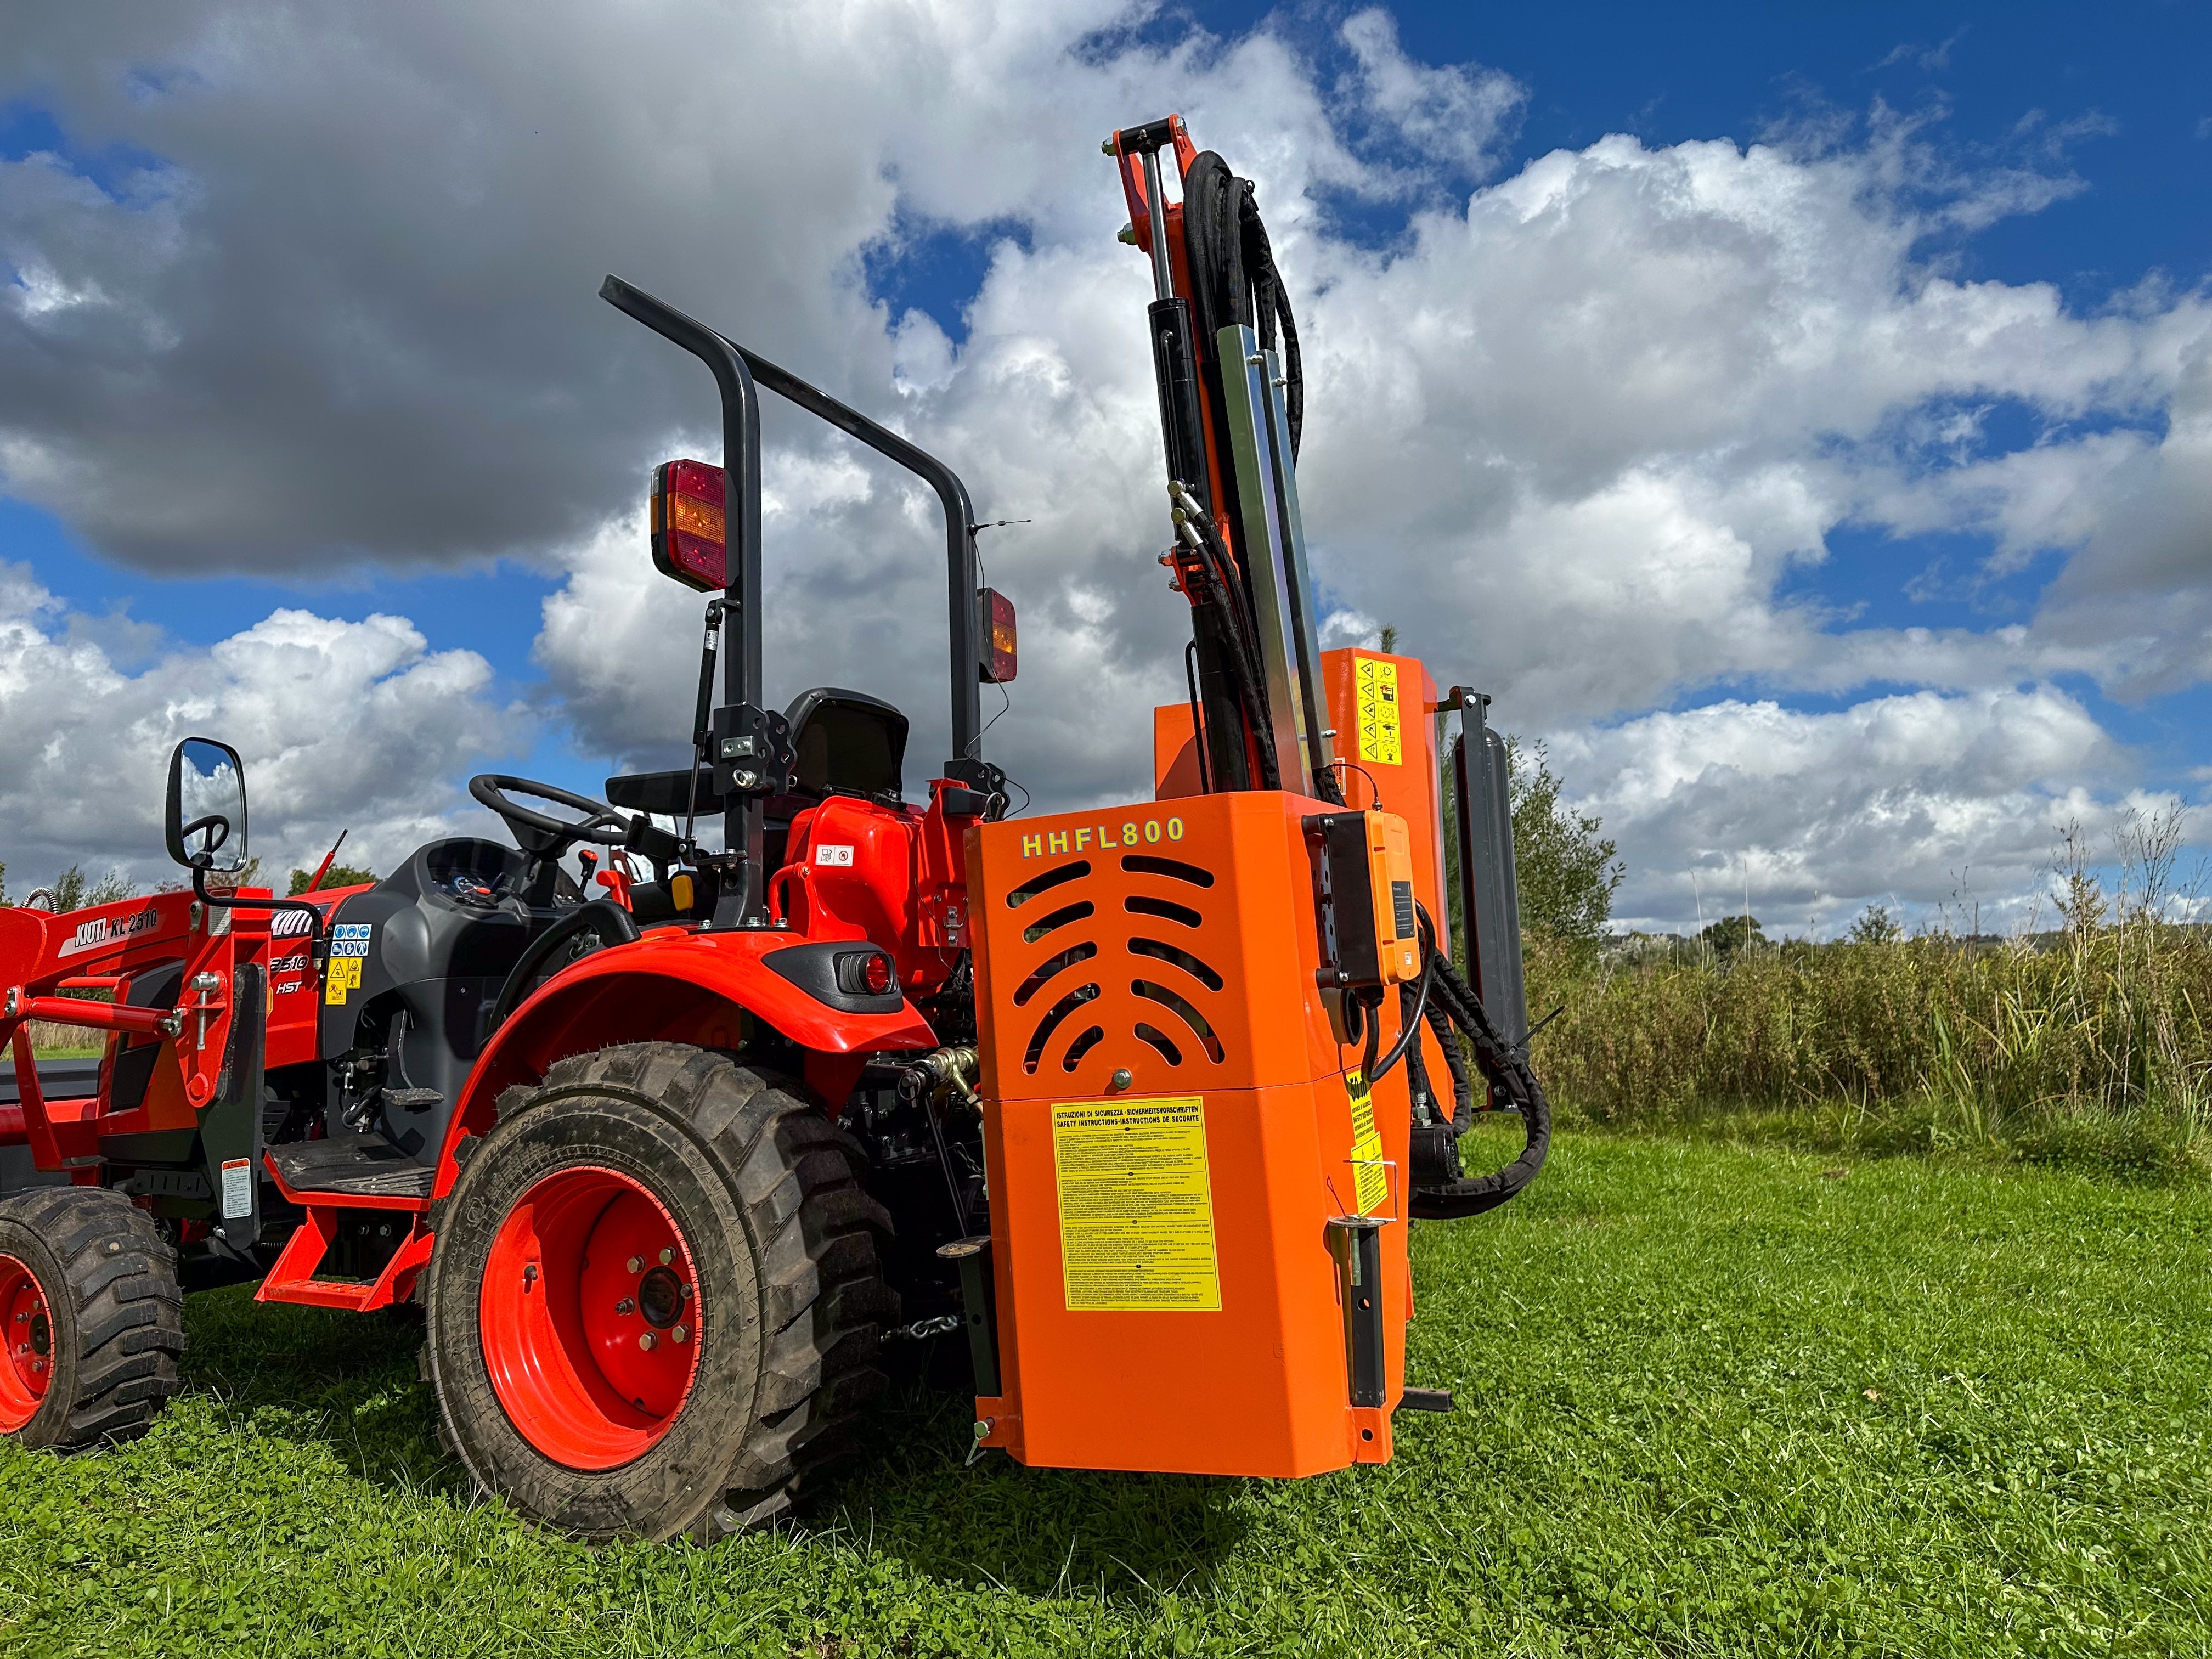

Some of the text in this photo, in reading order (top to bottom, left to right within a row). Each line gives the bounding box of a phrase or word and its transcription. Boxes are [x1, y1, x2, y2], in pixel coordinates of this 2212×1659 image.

[1022, 817, 1183, 859] HHFL800
[75, 908, 157, 947] KIOTI KL 2510
[271, 910, 313, 936] KIOTI
[270, 955, 309, 973] 2510
[276, 981, 302, 994] HST
[1350, 1076, 1359, 1102] 50
[1127, 1105, 1198, 1115] SICHERHEITSVORSCHRIFTEN
[1172, 1115, 1199, 1123] SECURITE
